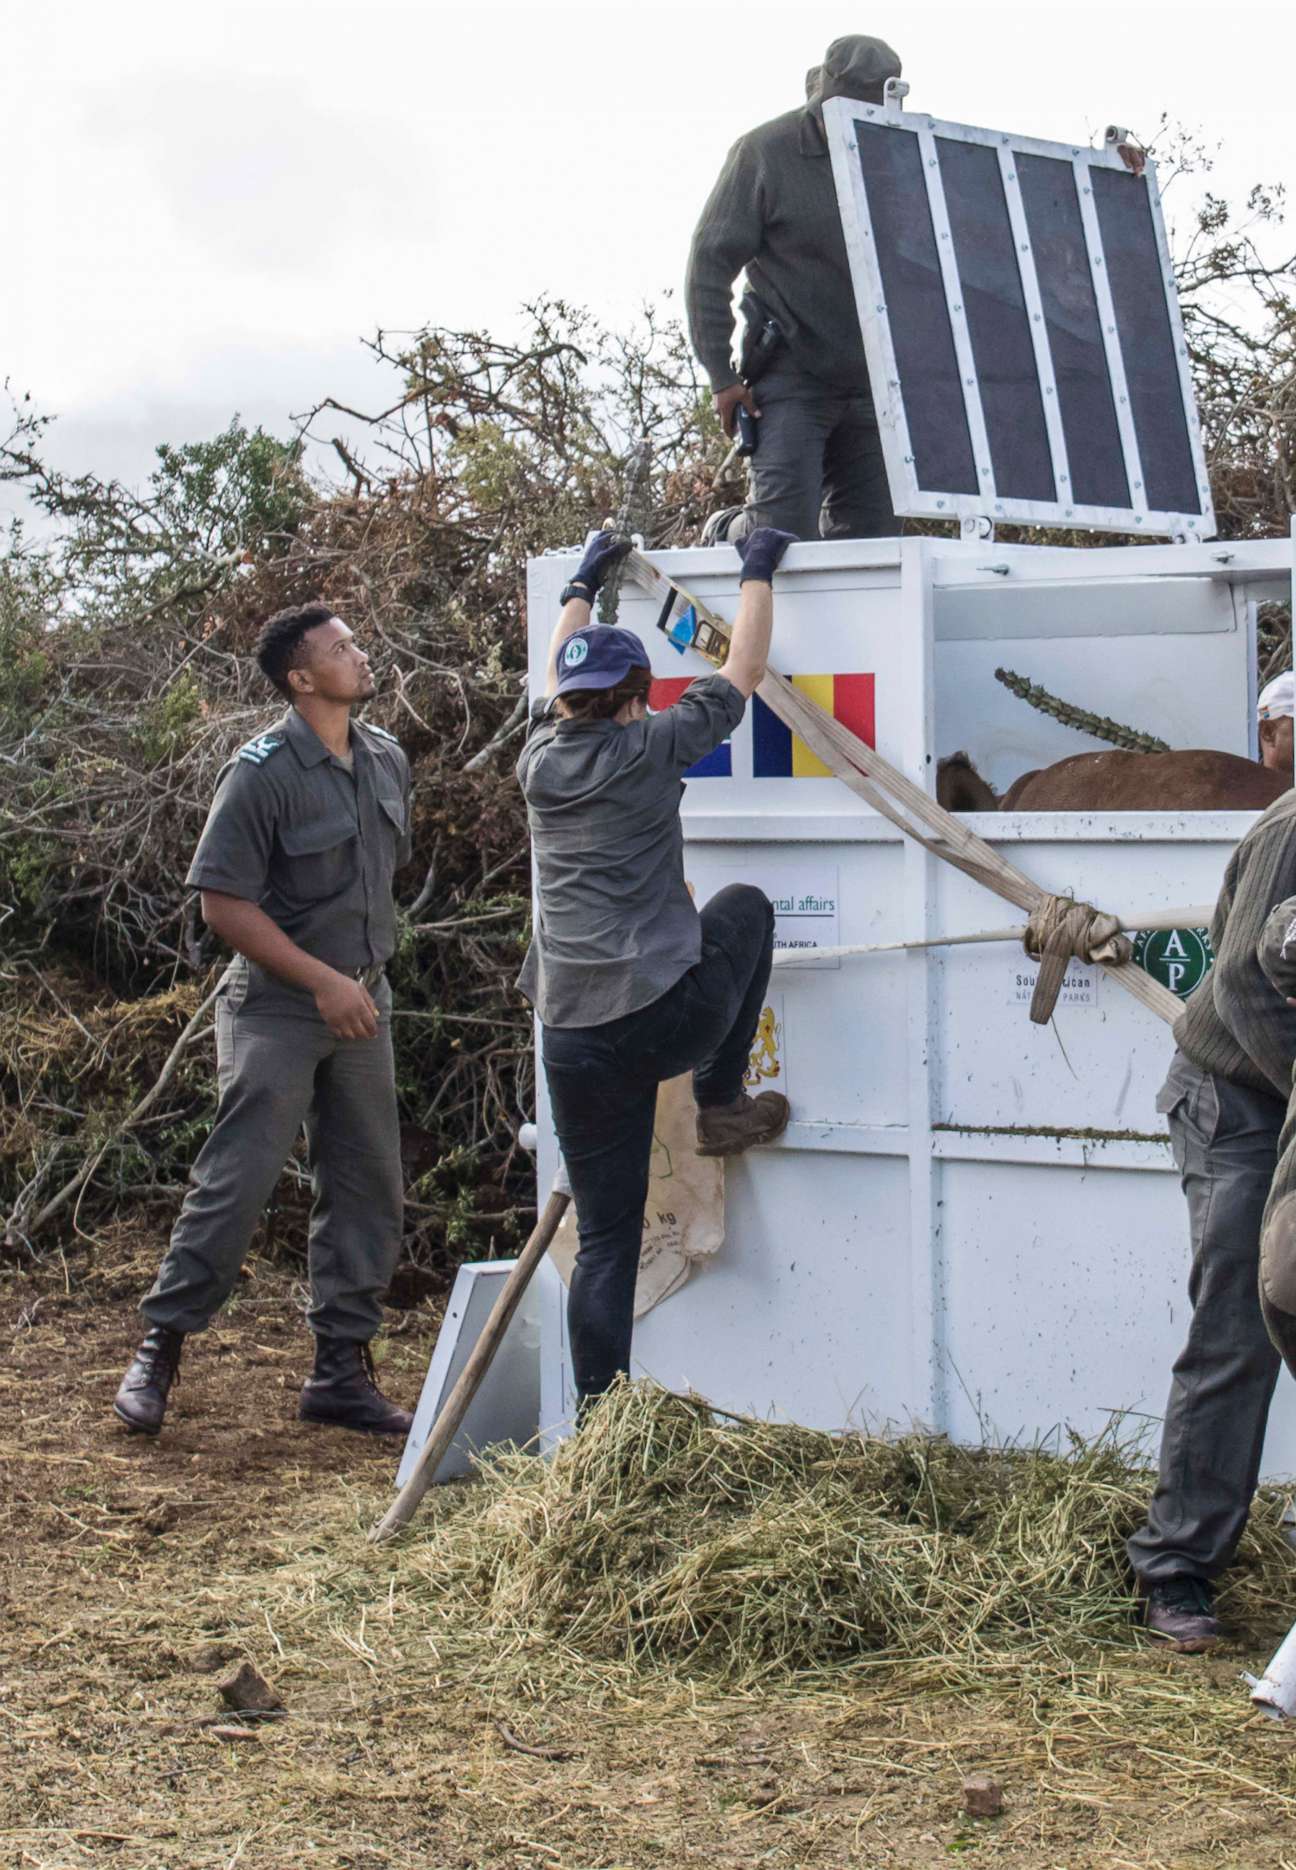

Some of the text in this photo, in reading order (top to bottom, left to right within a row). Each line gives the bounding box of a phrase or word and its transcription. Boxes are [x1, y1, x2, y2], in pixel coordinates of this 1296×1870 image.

[773, 895, 835, 911] ntal affairs
[789, 940, 818, 949] AFRICA
[1161, 928, 1188, 957] A
[1016, 974, 1035, 986] Sou
[1166, 962, 1185, 991] P
[1063, 993, 1091, 1002] PARKS
[656, 1211, 677, 1225] kg
